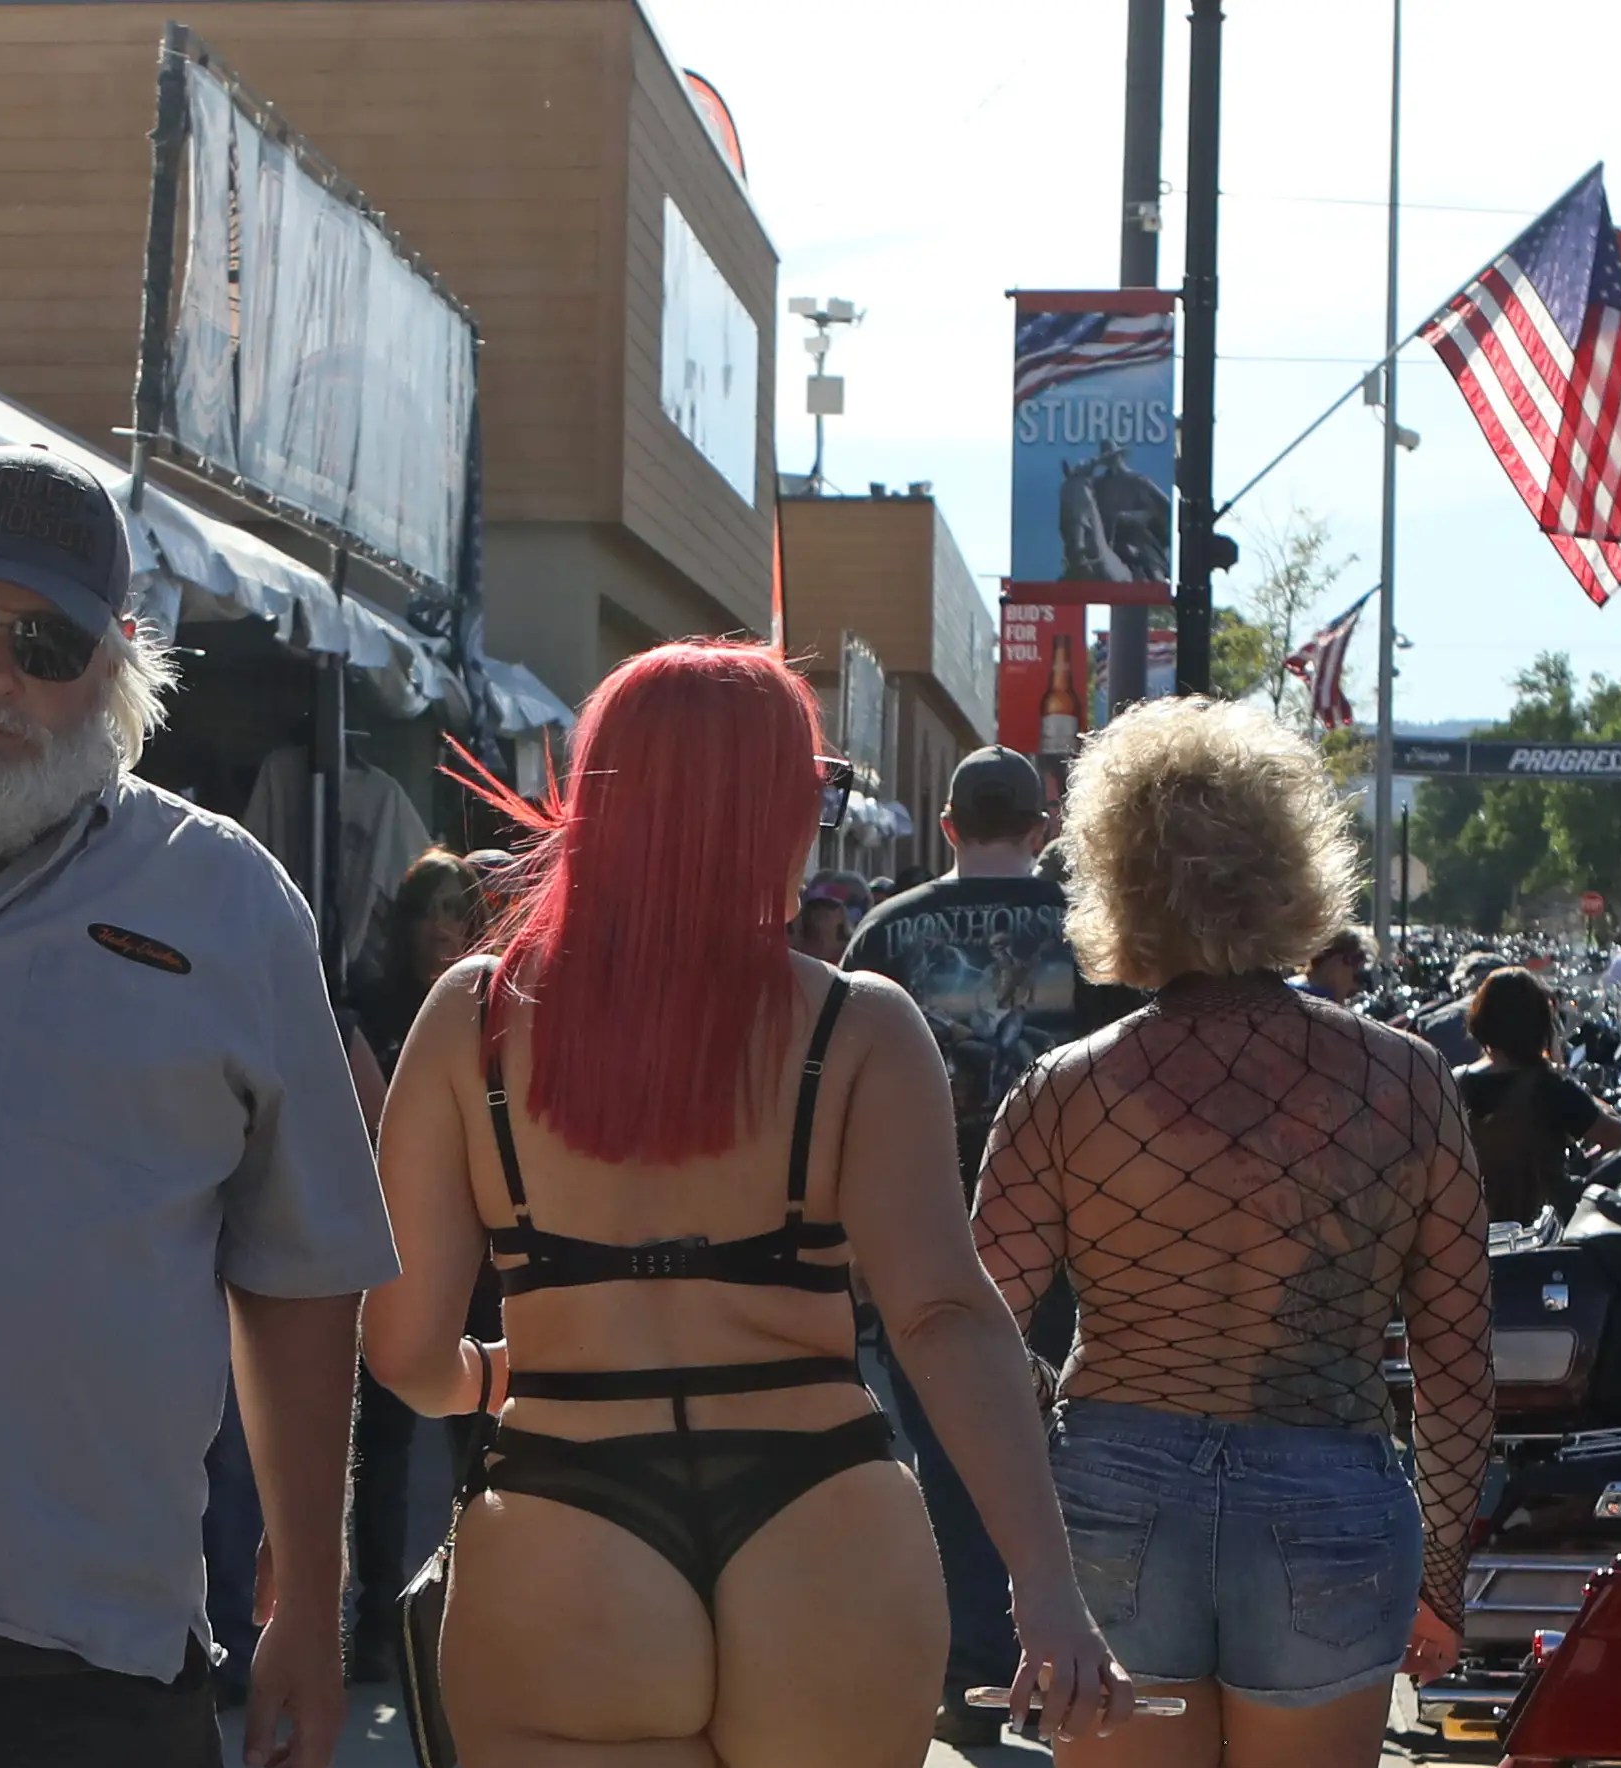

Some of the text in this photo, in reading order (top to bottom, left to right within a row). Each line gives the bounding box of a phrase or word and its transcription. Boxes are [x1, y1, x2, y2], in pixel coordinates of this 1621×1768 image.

[1018, 398, 1168, 445] STURGIS
[1005, 603, 1055, 623] BUD'S
[1005, 624, 1037, 642] FOR
[1005, 644, 1043, 663] YOU.
[884, 911, 959, 959] IRON
